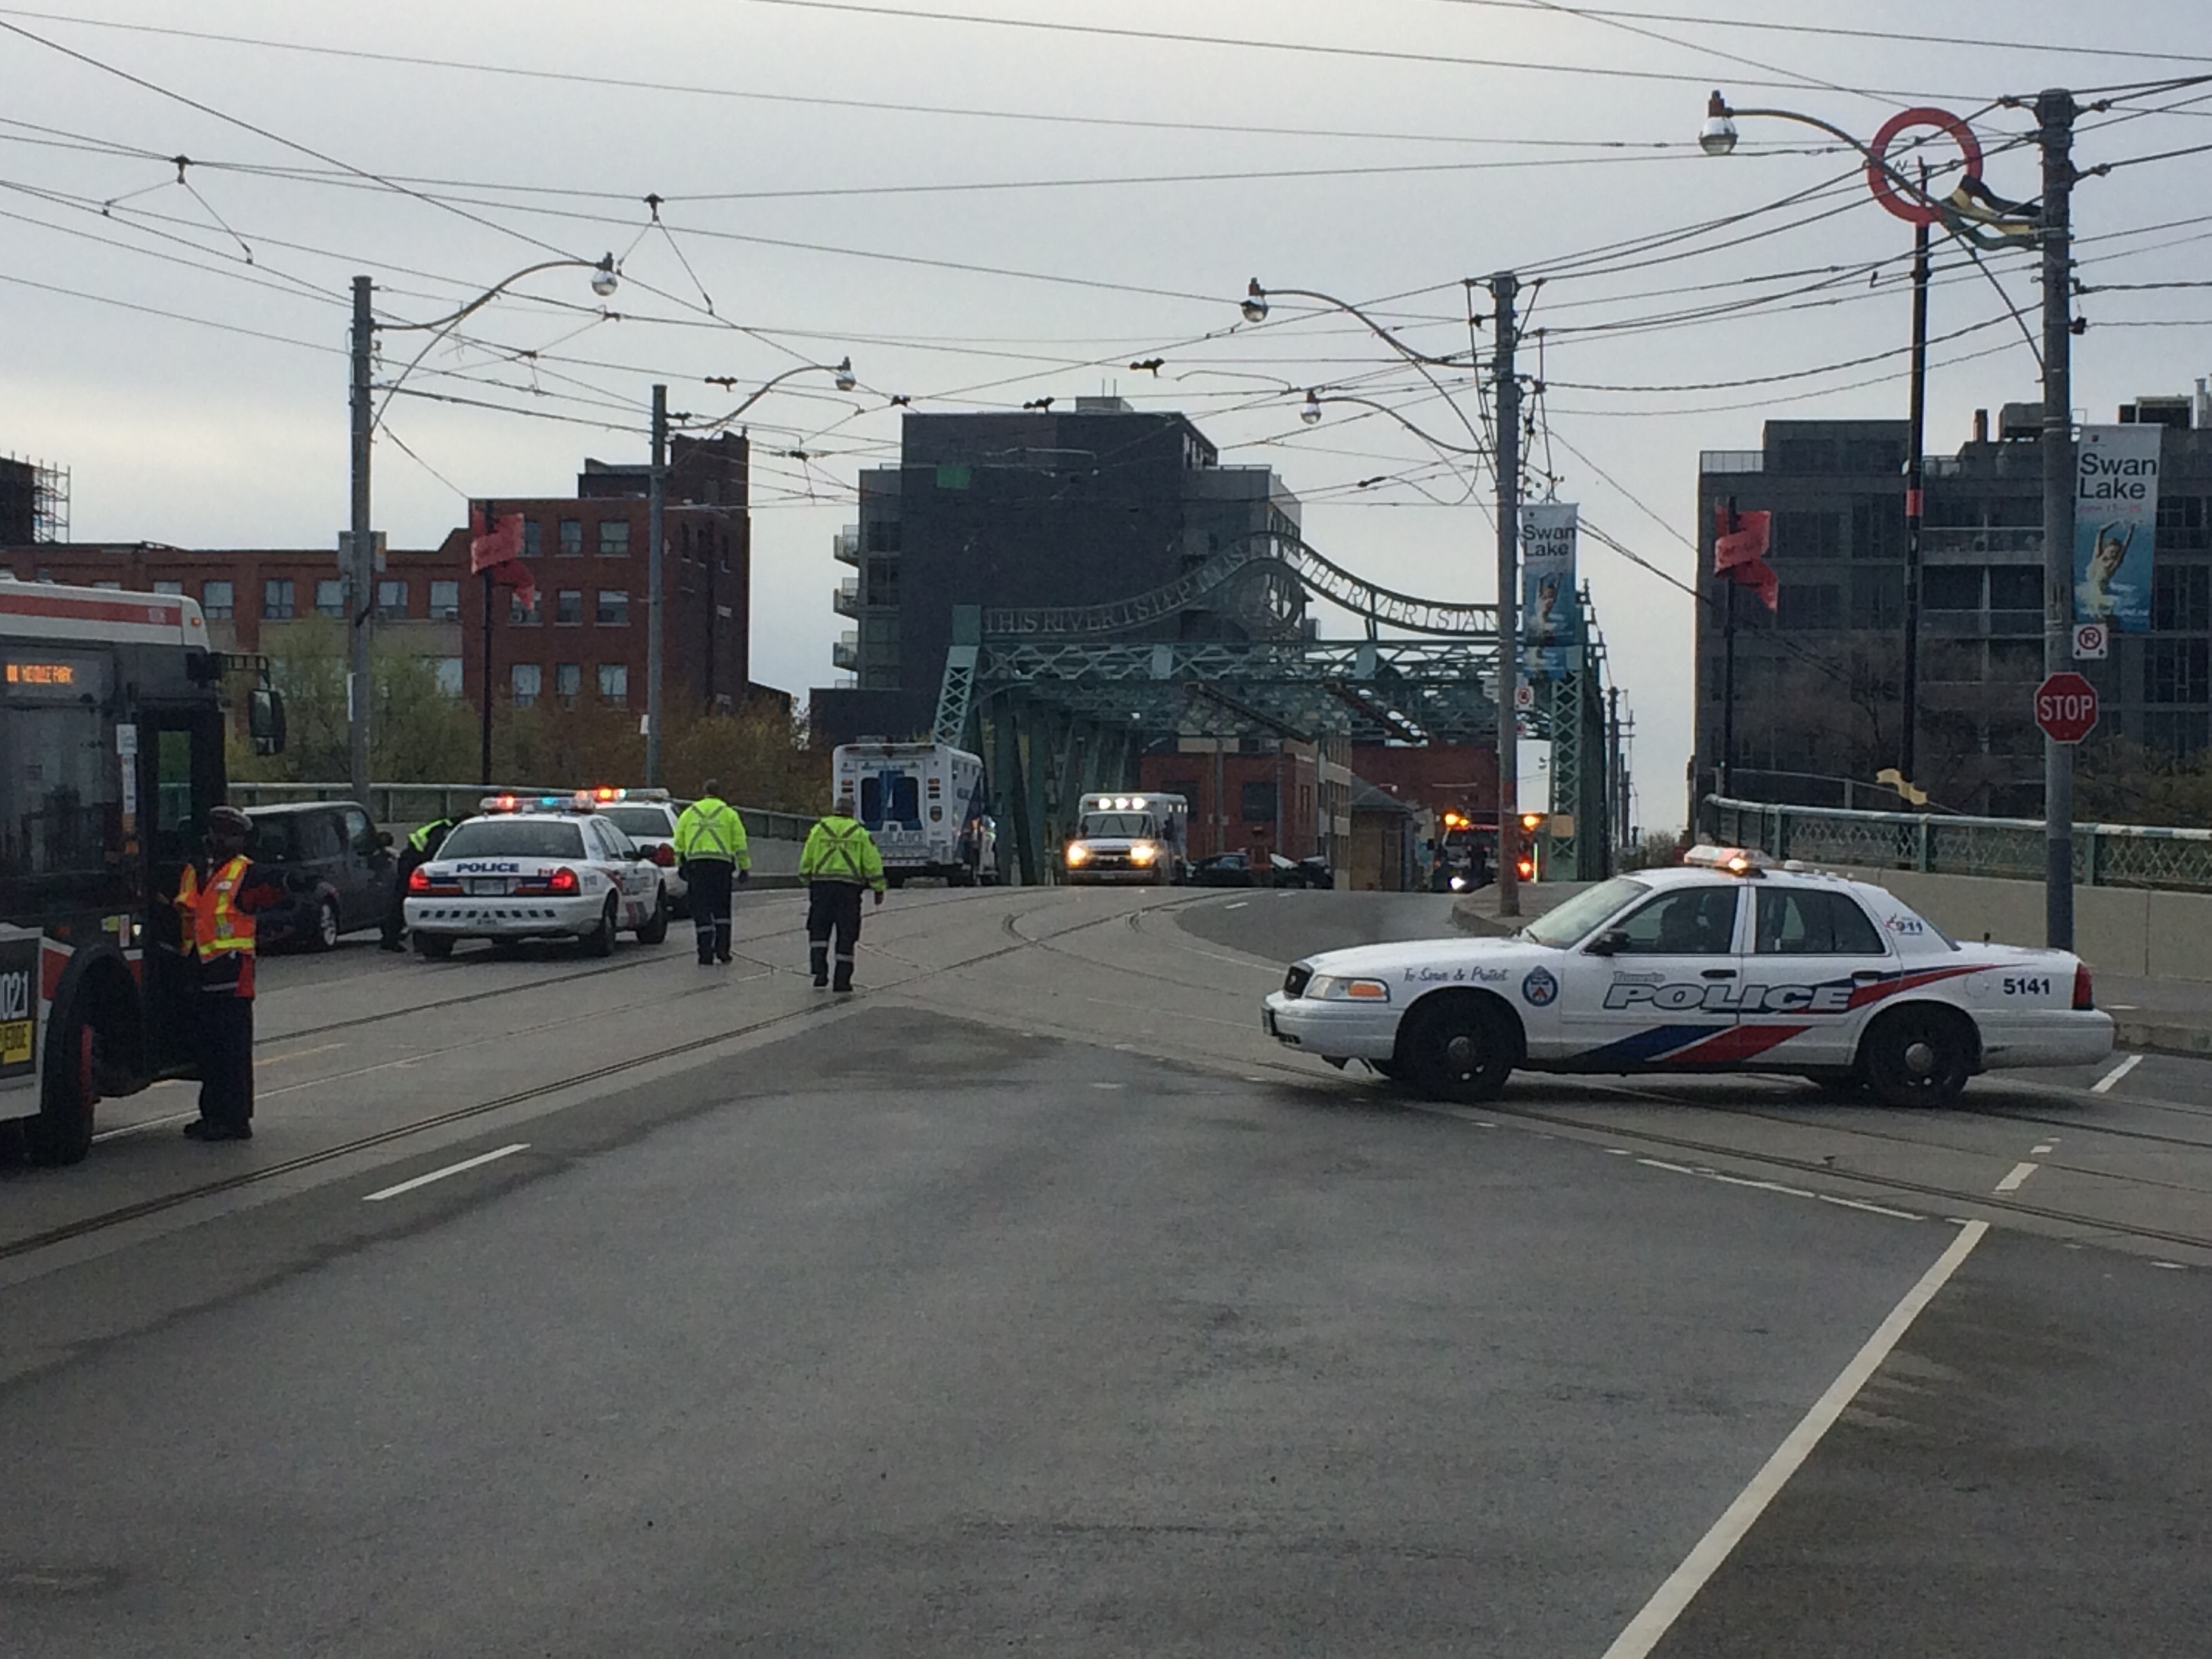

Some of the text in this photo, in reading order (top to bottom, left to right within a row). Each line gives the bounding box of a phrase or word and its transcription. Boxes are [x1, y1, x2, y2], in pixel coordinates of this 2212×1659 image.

[2080, 452, 2156, 476] Swan
[2080, 476, 2146, 499] Lake
[1525, 525, 1576, 540] Swan
[1525, 541, 1569, 557] Lake
[986, 611, 1038, 633] THIS
[1042, 605, 1114, 632] RIVER
[1347, 583, 1418, 626] RIVER
[1436, 608, 1518, 632] STAN
[2039, 694, 2093, 722] STOP
[455, 861, 519, 874] POLICE
[1603, 983, 1856, 1011] POLICE
[2003, 977, 2050, 996] 5141
